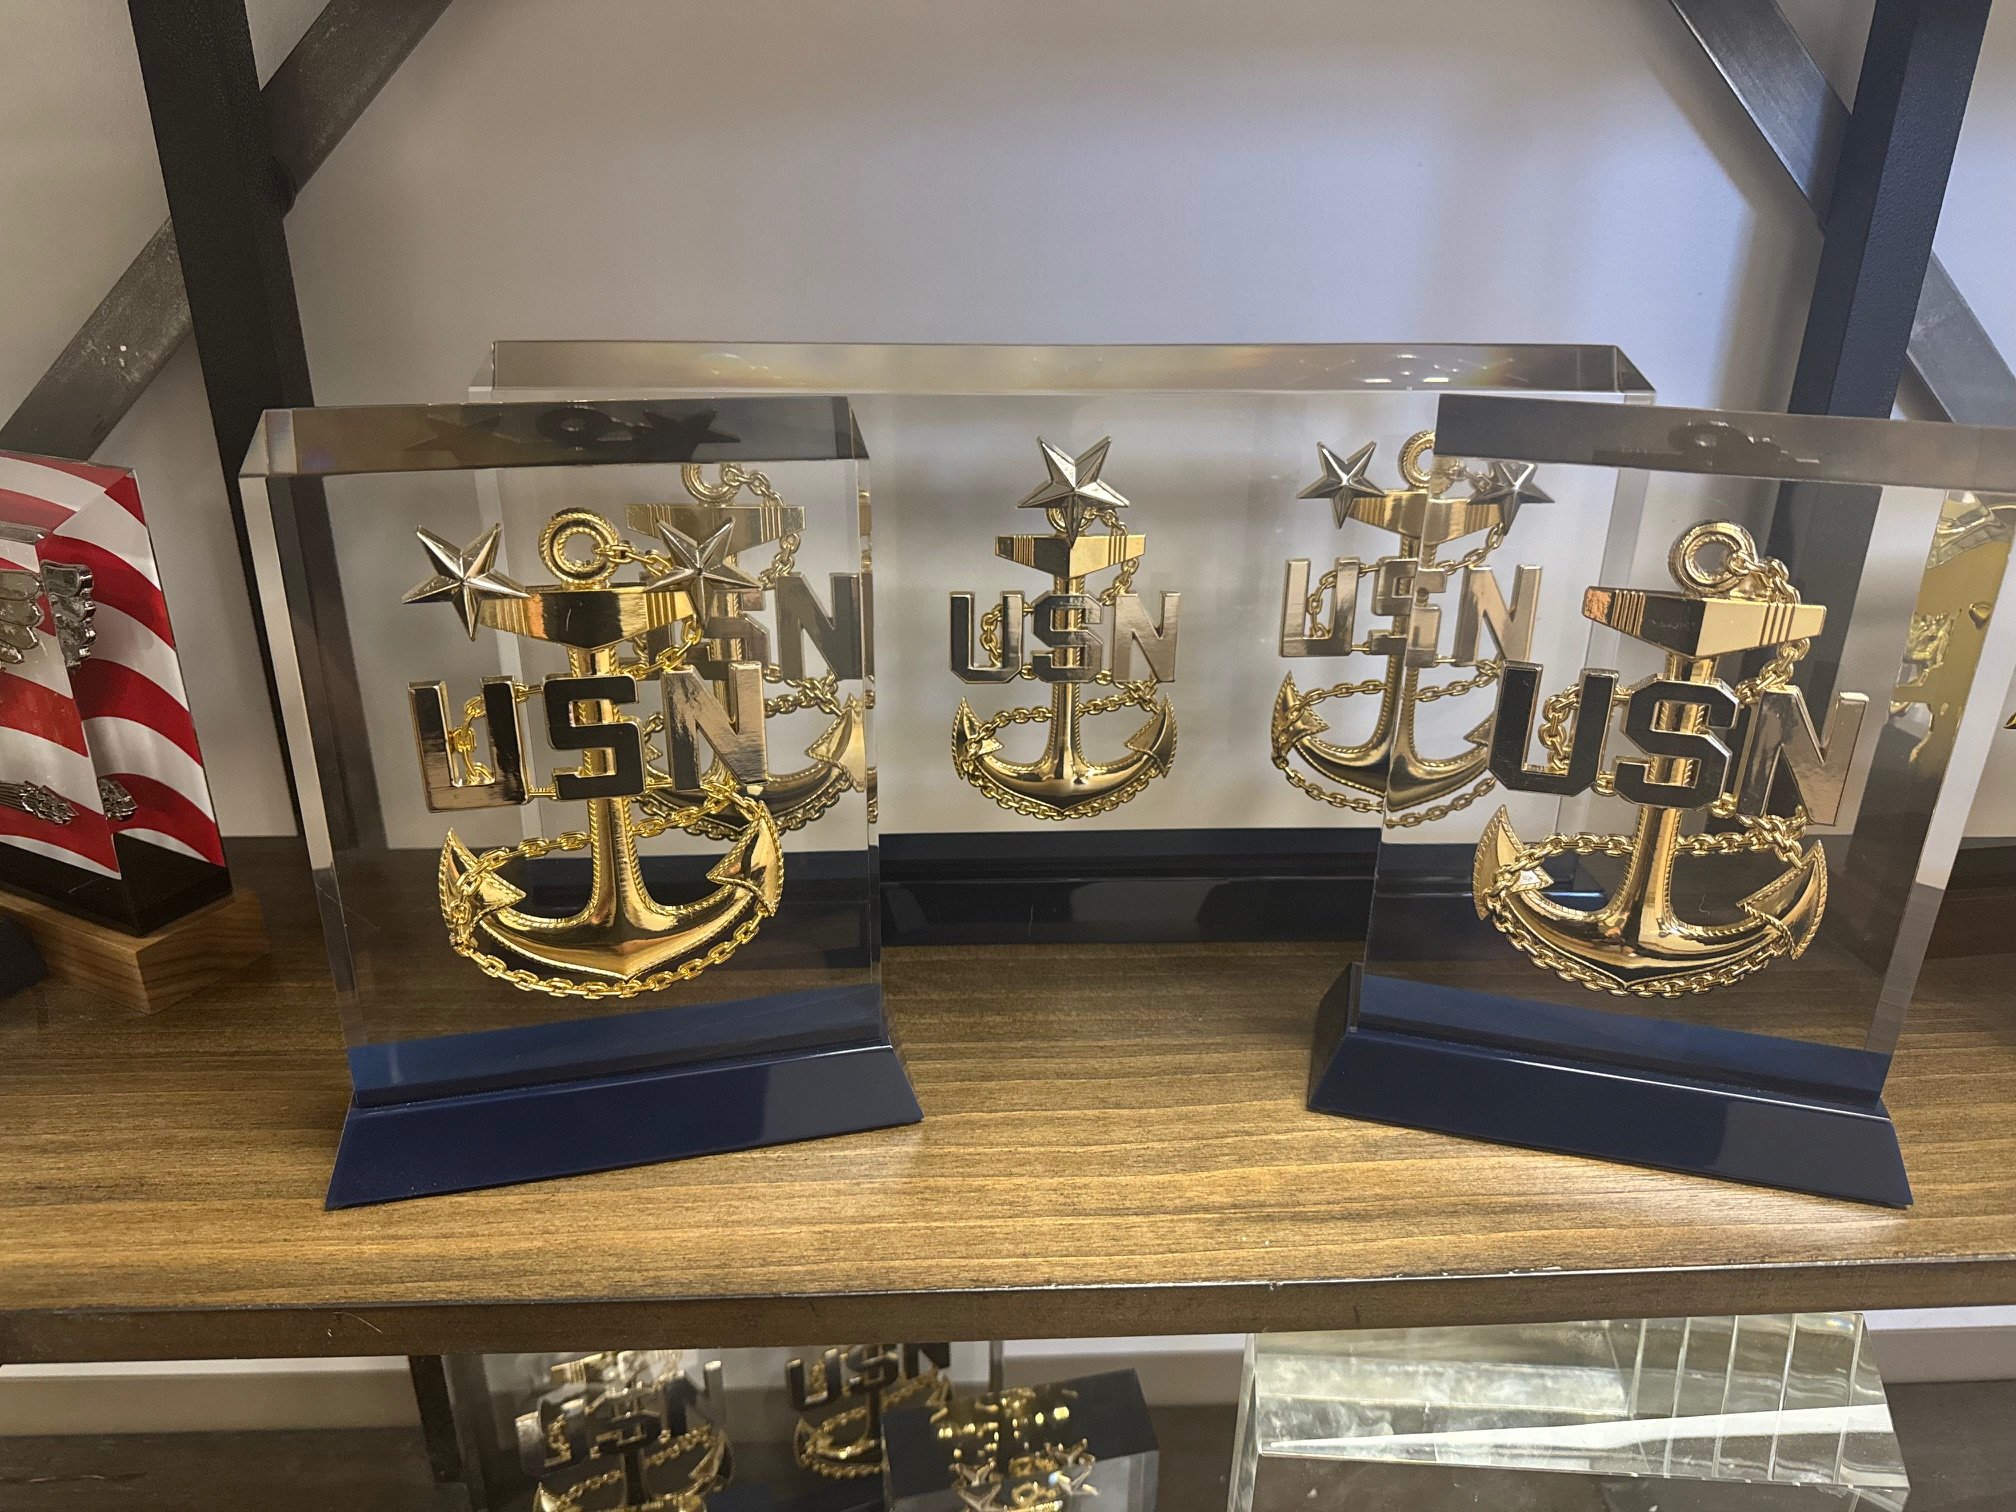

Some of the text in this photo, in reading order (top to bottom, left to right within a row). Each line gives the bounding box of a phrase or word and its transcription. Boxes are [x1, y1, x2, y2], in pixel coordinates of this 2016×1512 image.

[949, 590, 1181, 684] USN
[1279, 557, 1542, 667] USN
[408, 661, 769, 813] USN
[1487, 660, 1869, 826] USN
